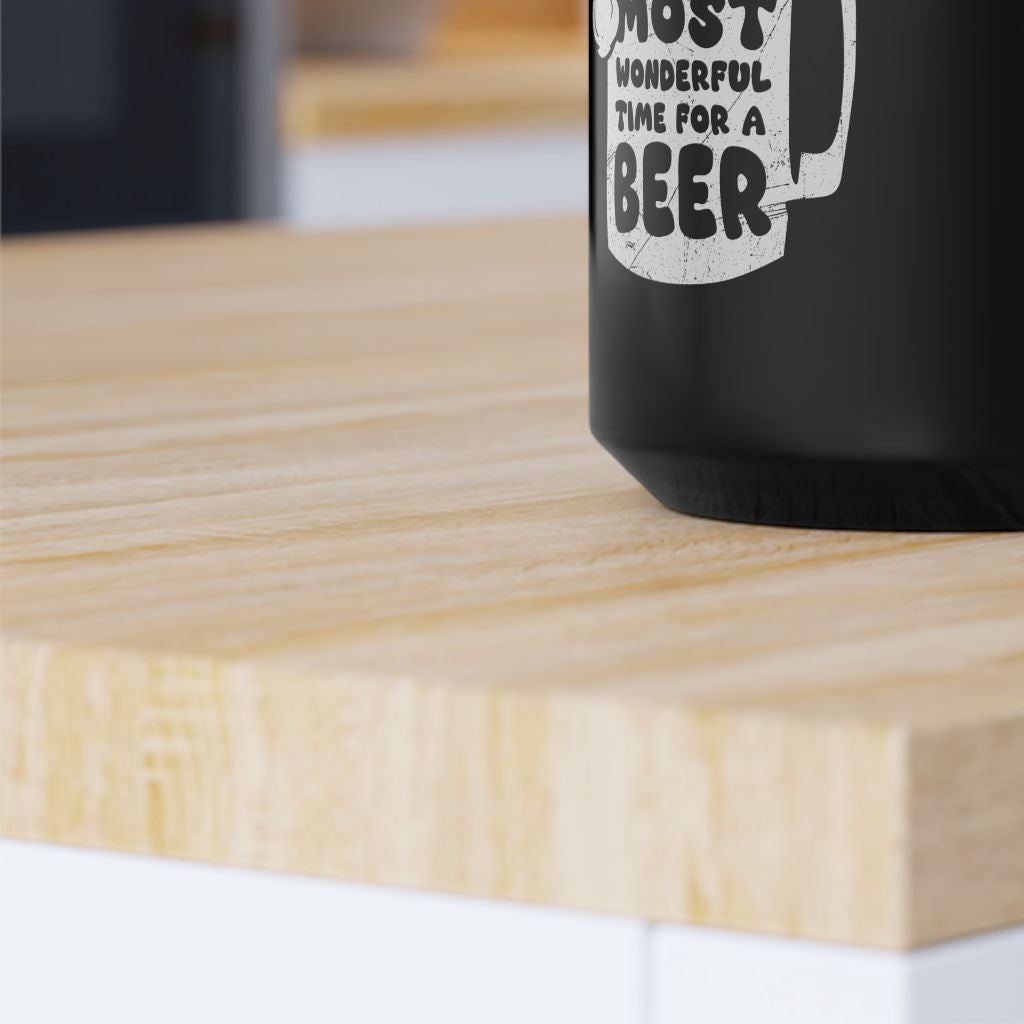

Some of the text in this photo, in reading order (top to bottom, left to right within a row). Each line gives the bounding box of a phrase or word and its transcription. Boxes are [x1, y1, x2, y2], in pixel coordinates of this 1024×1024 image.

[615, 56, 772, 93] WONDERFUL
[615, 99, 766, 136] TIME FOR A
[614, 141, 772, 240] BEER
